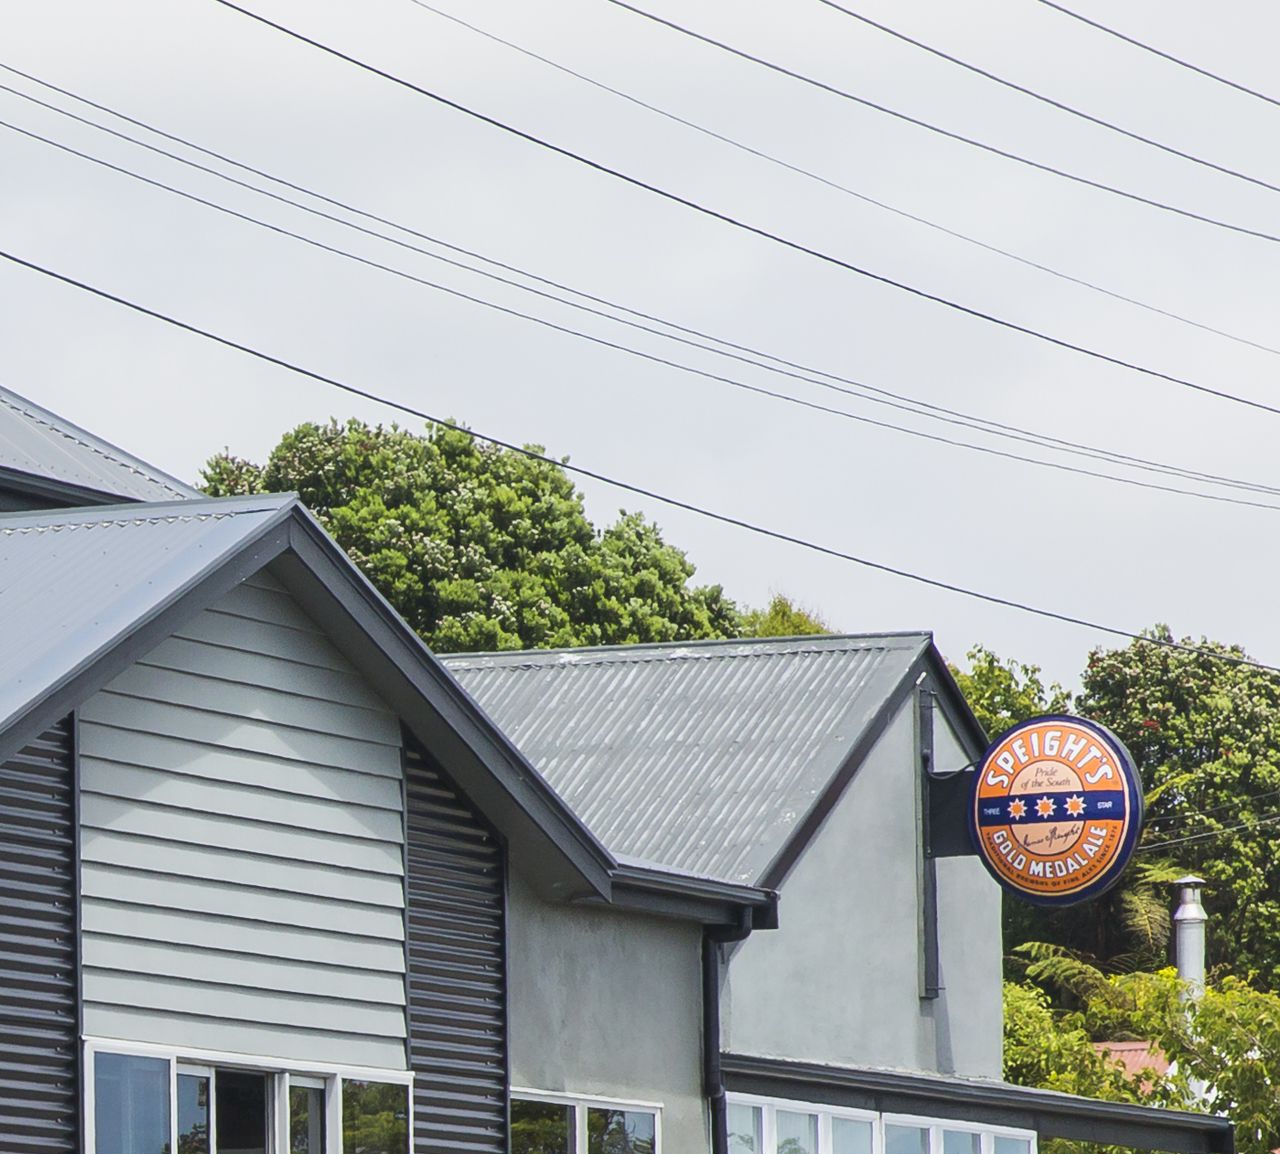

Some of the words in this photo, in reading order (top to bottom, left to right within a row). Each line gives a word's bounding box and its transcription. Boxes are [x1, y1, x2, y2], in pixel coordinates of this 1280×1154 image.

[986, 730, 1113, 788] SPEIGHT'S
[993, 830, 1027, 870] GOLD
[1029, 853, 1088, 877] MEDAL
[1082, 826, 1107, 858] ALE
